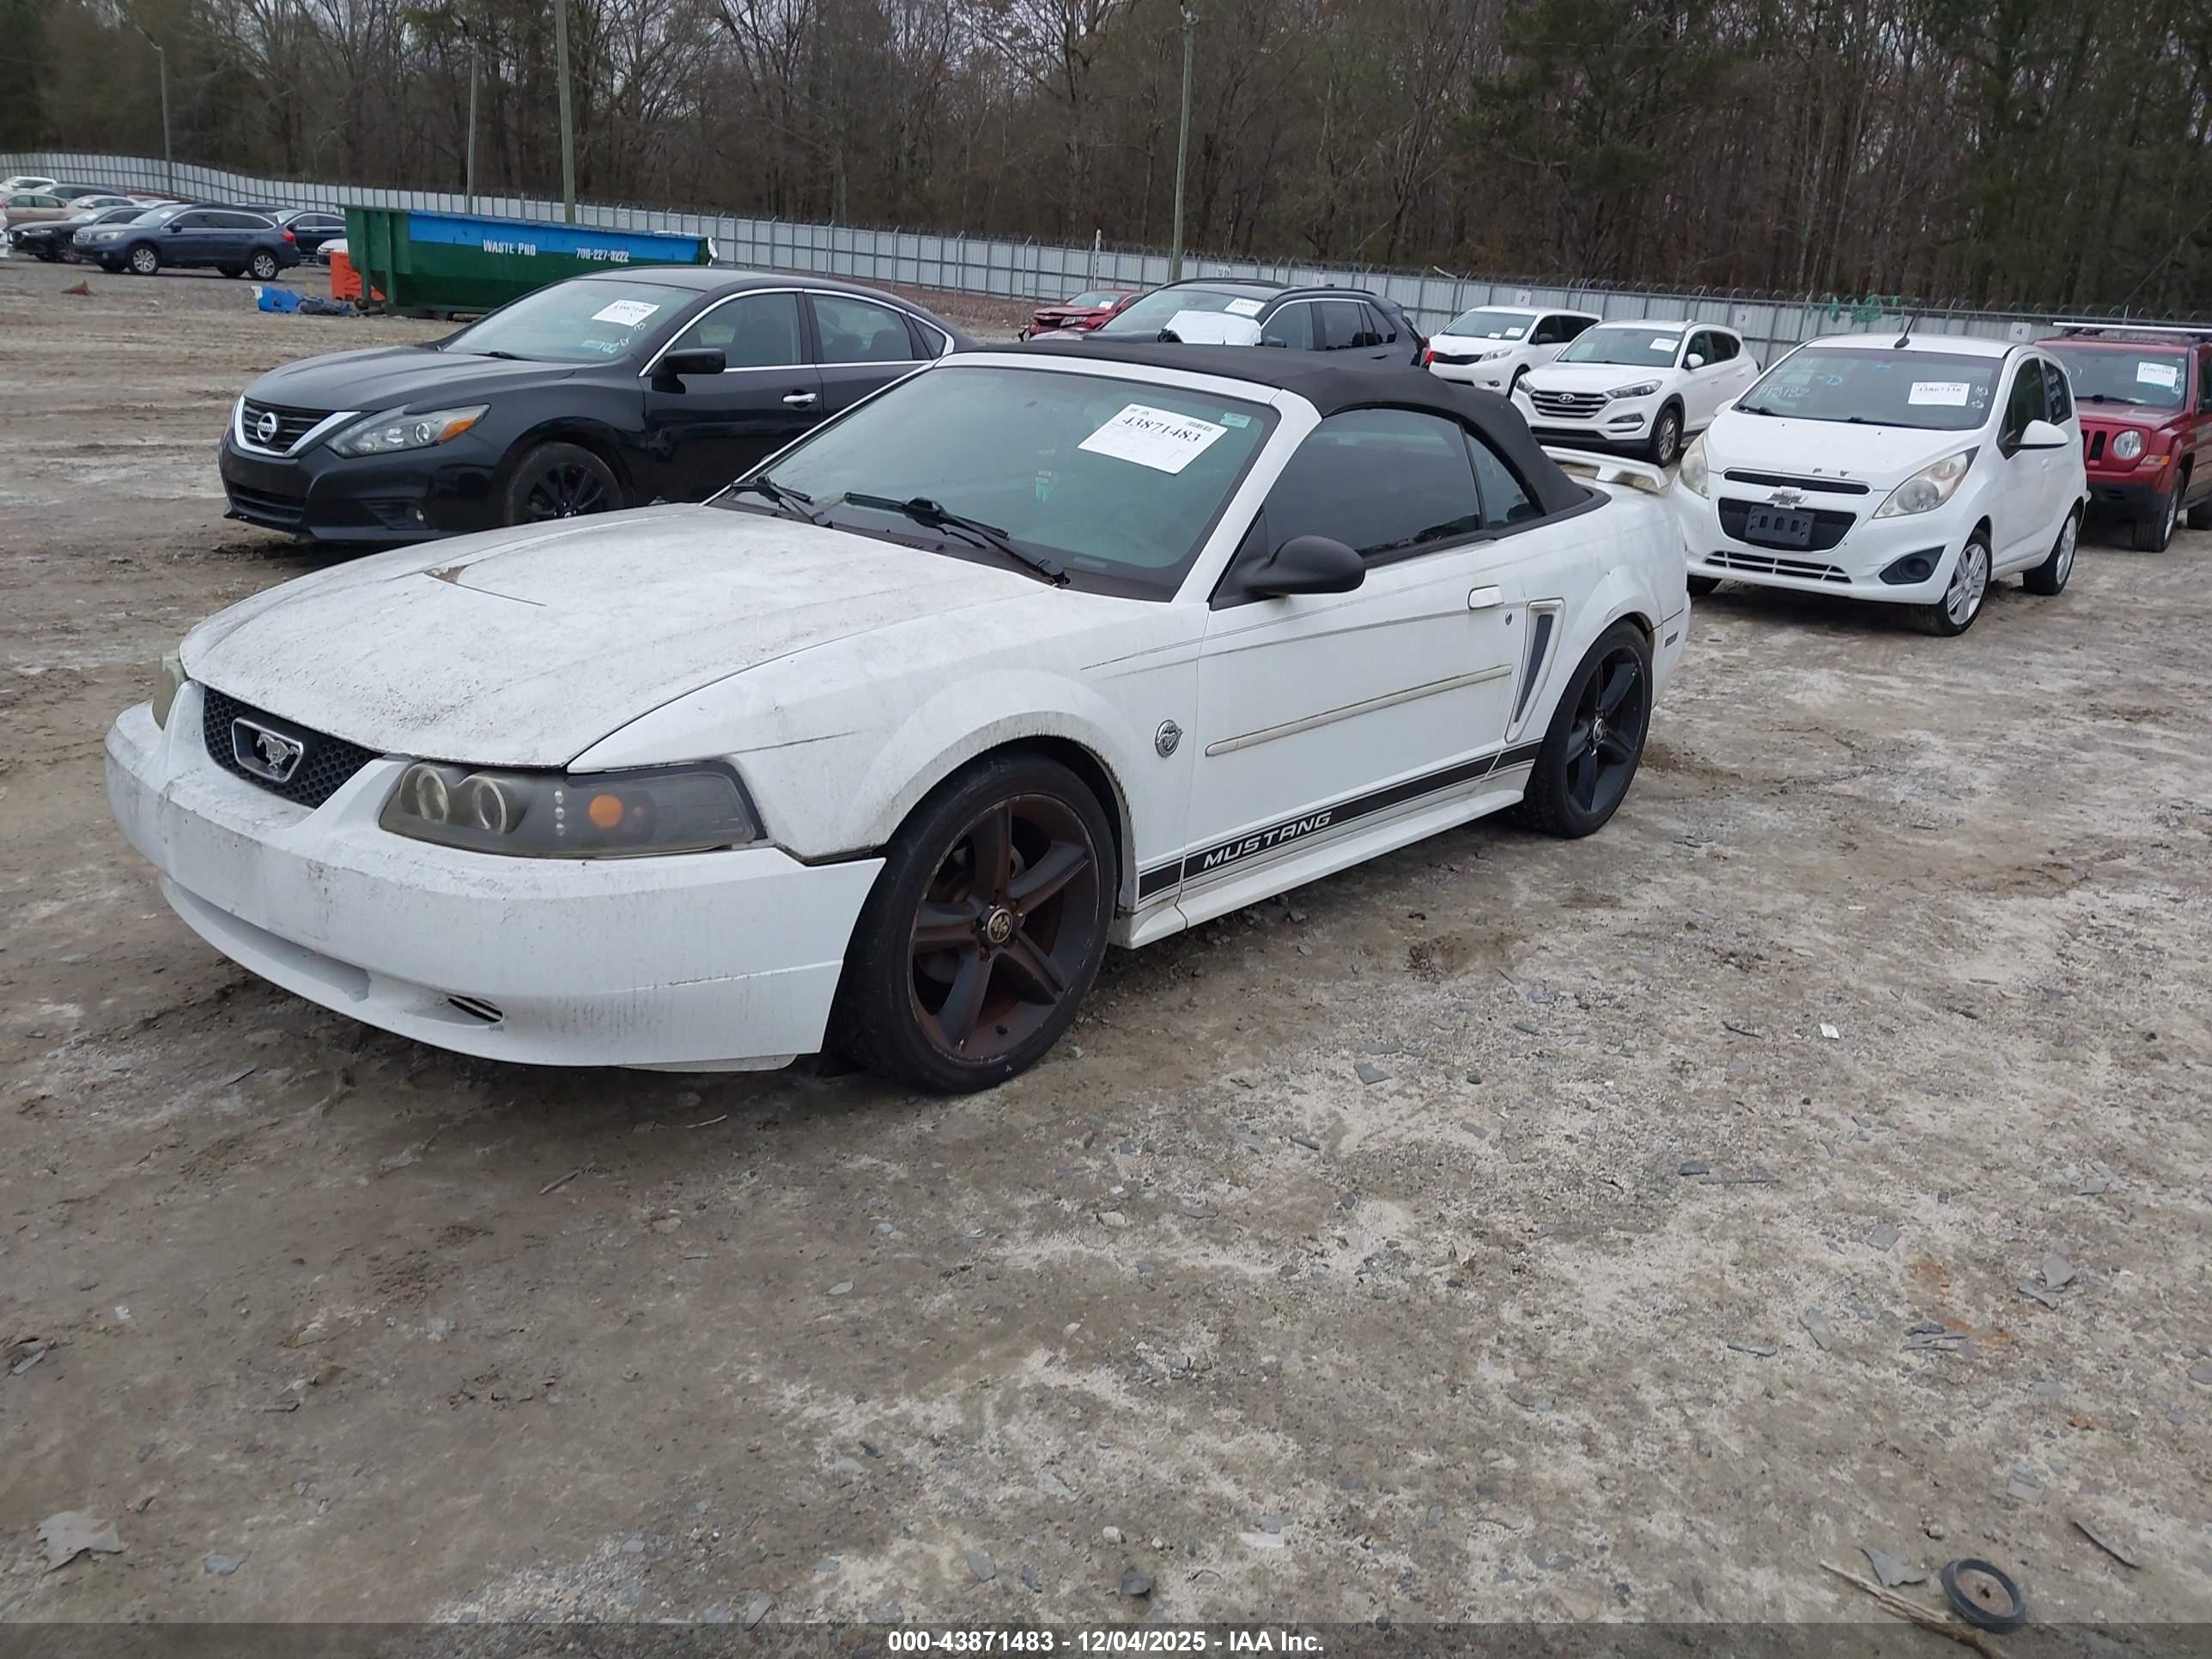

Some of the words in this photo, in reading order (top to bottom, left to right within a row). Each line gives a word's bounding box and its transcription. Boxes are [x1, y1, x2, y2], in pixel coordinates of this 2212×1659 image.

[483, 239, 514, 255] WASTE
[518, 241, 537, 256] PRO
[1121, 416, 1201, 442] 43871483
[1203, 811, 1333, 869] MUSTANG
